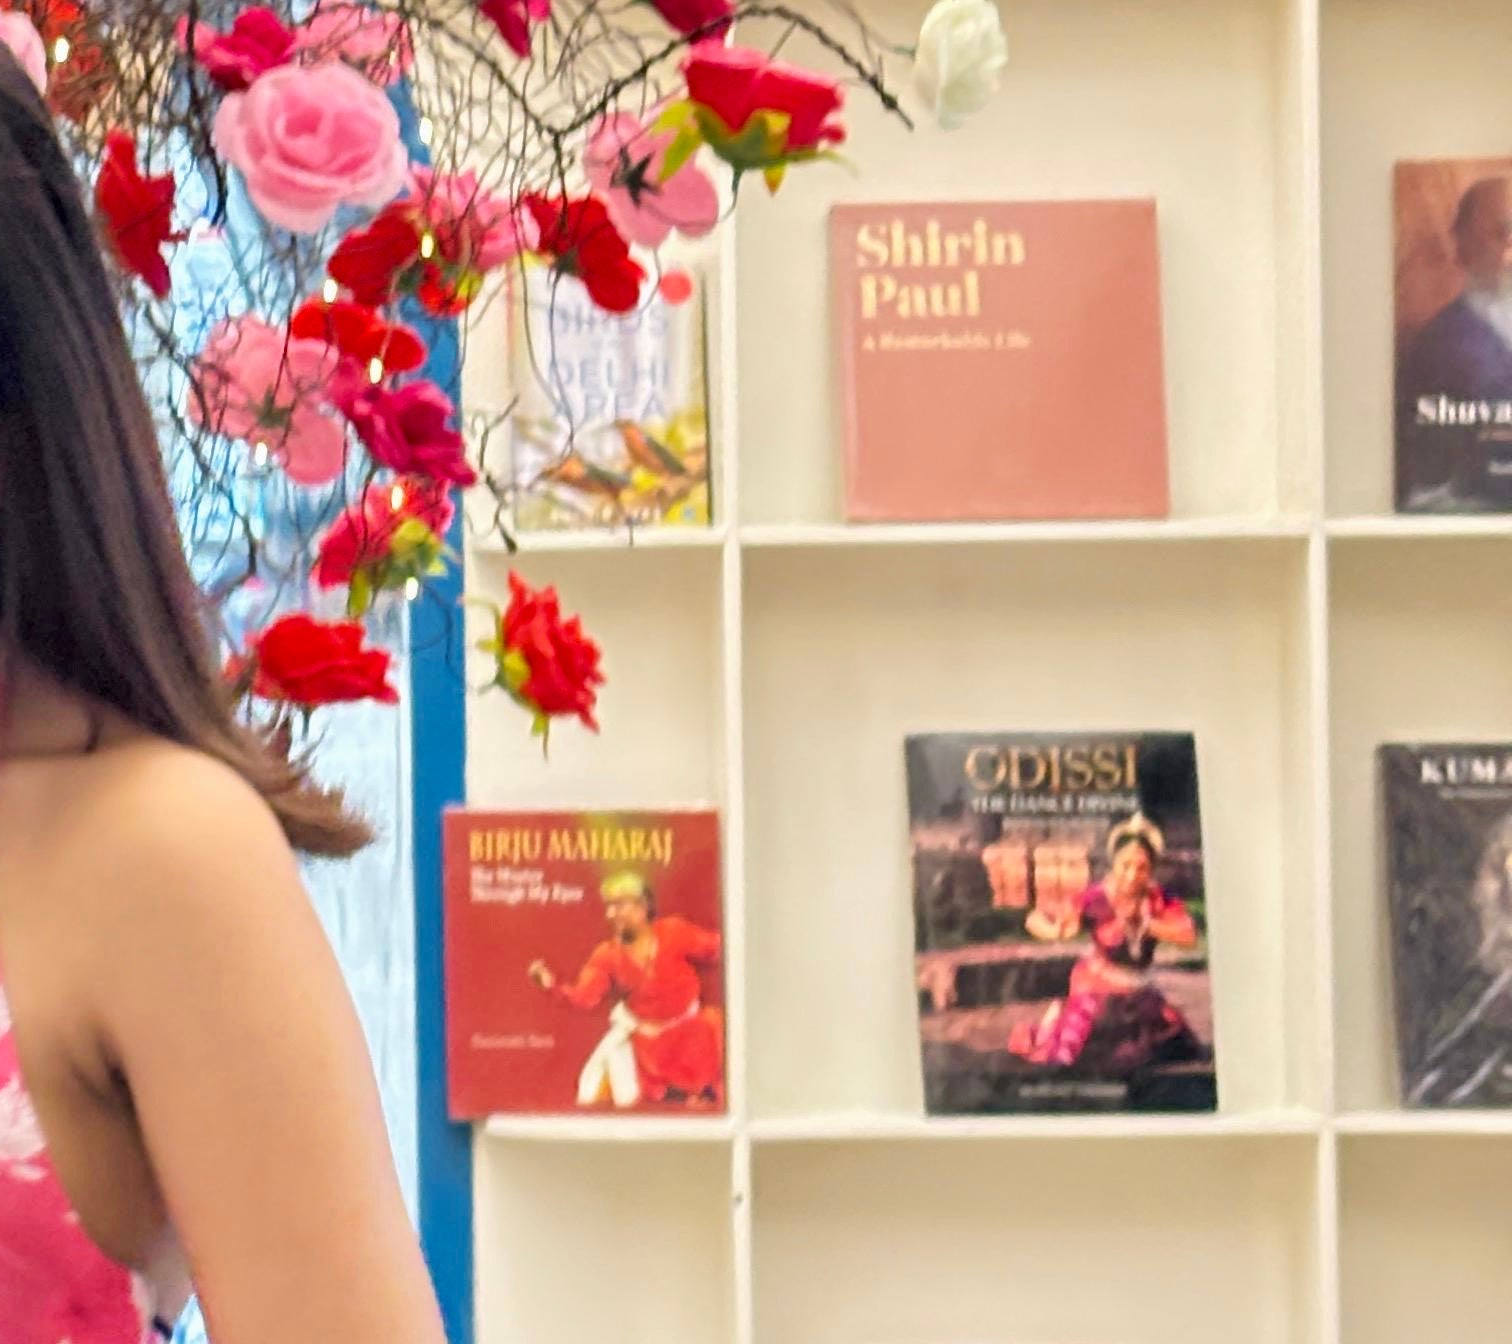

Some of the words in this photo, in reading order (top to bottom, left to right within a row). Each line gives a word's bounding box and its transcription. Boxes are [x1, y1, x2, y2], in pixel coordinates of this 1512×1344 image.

[856, 219, 1026, 268] Shirin
[861, 270, 981, 320] Paul
[964, 742, 1137, 792] ODISSI
[470, 828, 541, 866] BIRJU
[547, 828, 673, 870] MAHARAJ
